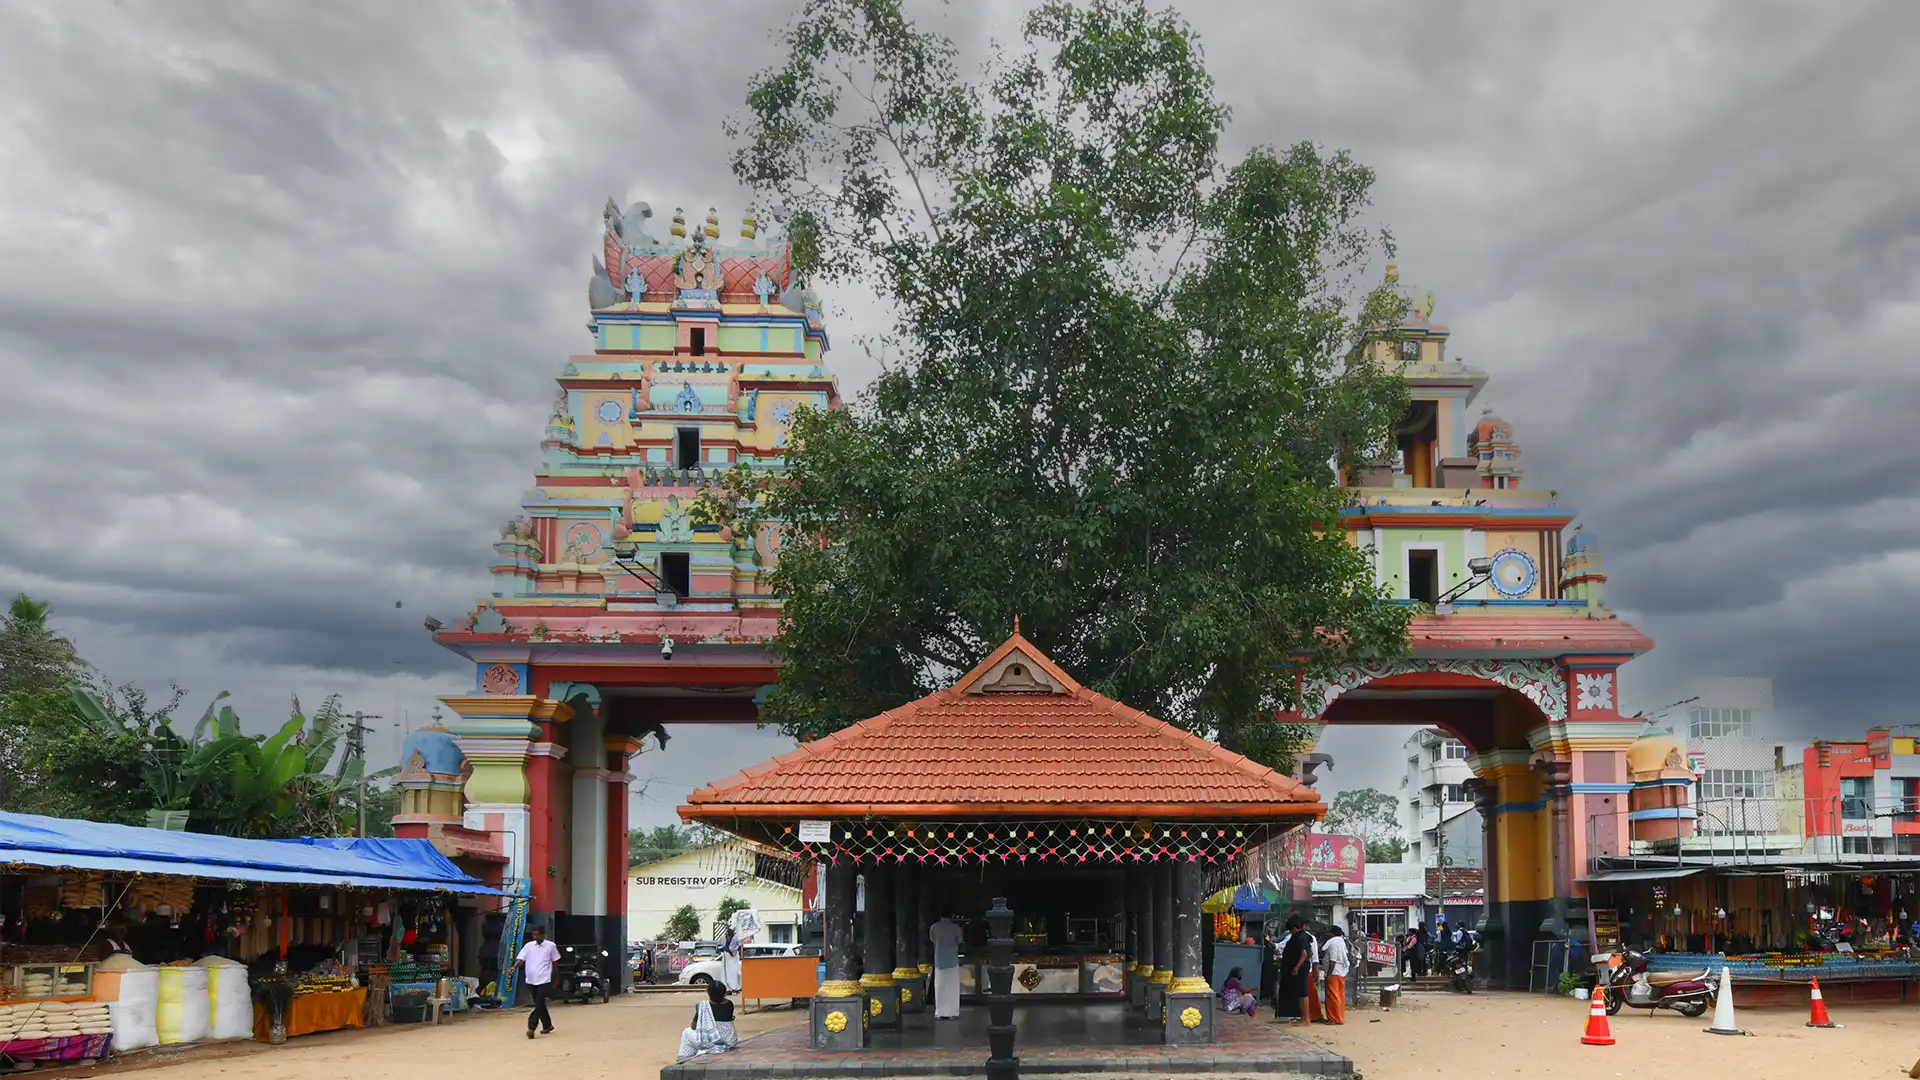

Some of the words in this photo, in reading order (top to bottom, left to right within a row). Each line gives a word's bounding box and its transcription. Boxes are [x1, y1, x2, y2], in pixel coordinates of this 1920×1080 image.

[636, 876, 656, 885] SUB
[658, 876, 707, 886] REGISTRY
[1377, 944, 1387, 953] NO
[1367, 952, 1396, 963] PARKING
